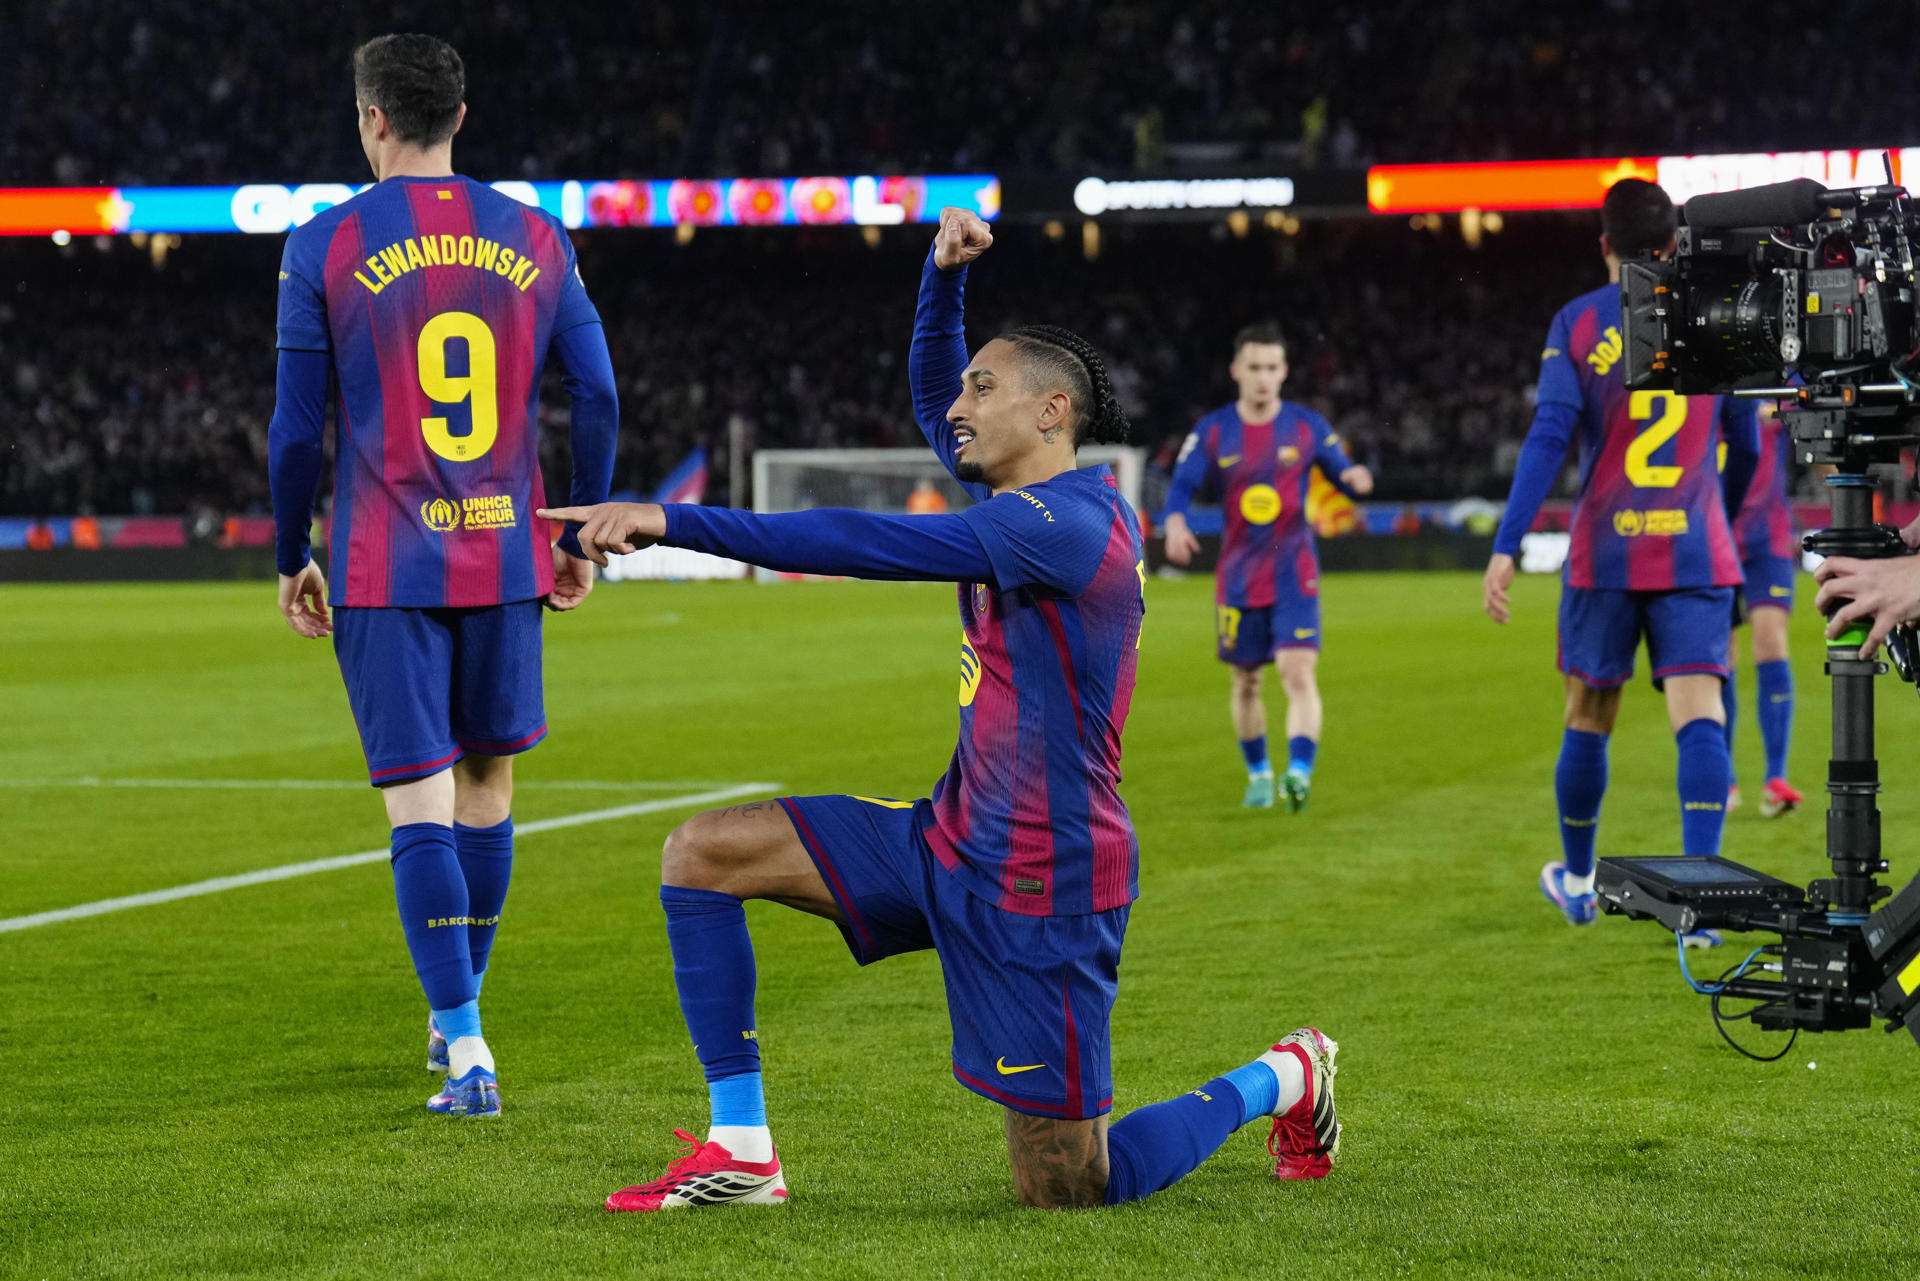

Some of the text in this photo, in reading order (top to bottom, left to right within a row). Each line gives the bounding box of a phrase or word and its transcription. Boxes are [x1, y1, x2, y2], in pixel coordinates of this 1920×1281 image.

[353, 234, 541, 295] LEWANDOWSKI
[417, 311, 499, 462] 9
[1624, 389, 1688, 488] 2
[462, 495, 512, 511] UNHCR
[464, 509, 515, 525] ACNUR
[467, 914, 499, 927] ARÇA
